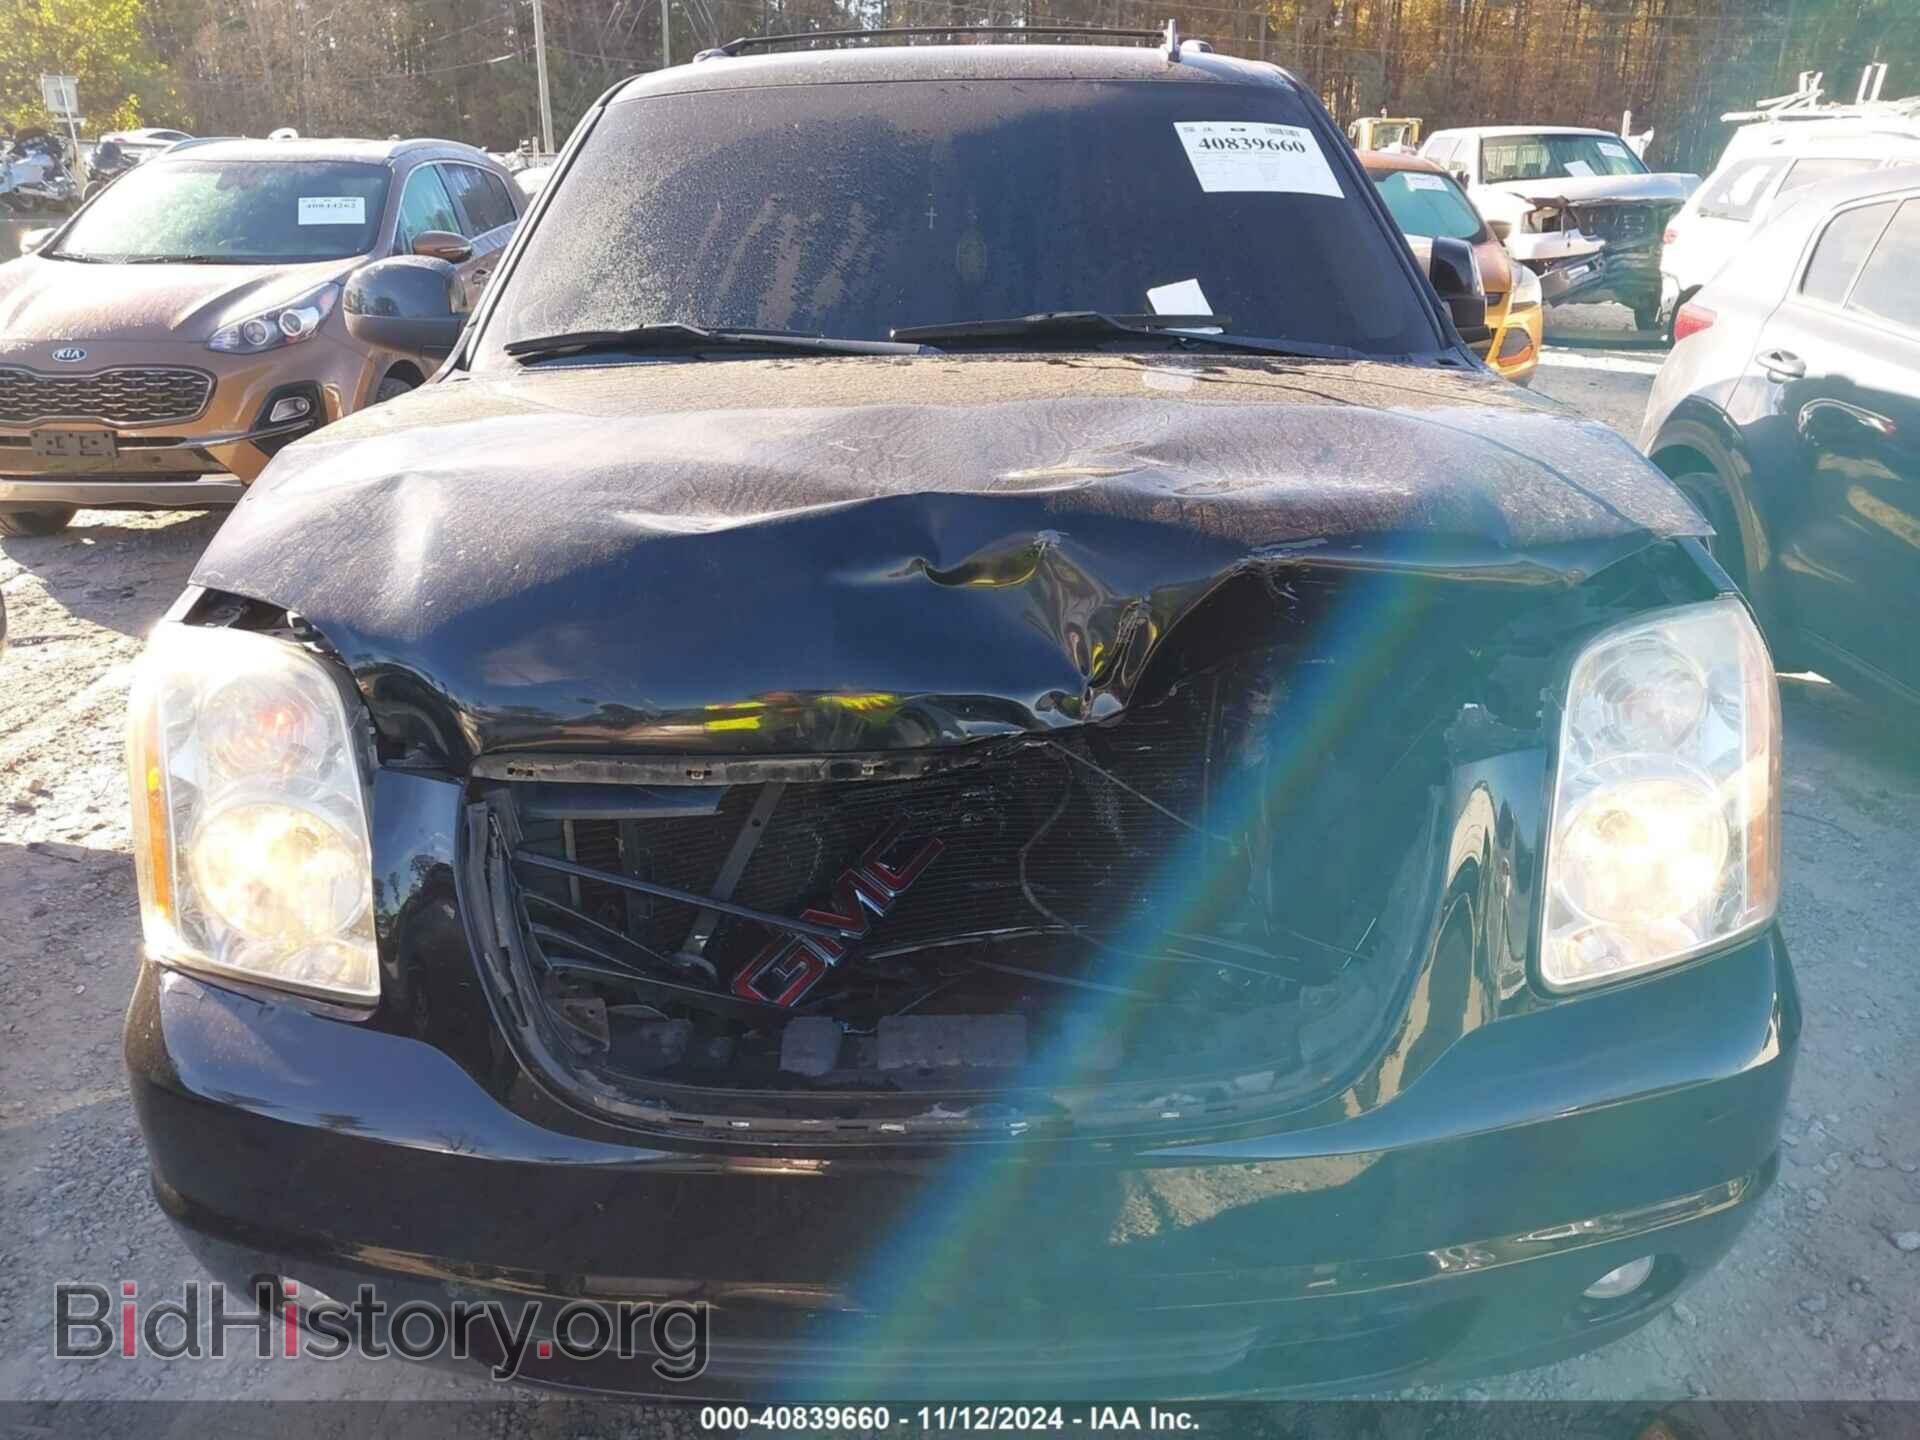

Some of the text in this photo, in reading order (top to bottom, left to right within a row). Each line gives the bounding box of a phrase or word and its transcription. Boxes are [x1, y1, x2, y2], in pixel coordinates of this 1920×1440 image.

[1199, 137, 1306, 153] 40839660
[57, 350, 80, 358] KIA
[732, 822, 944, 1008] GMC
